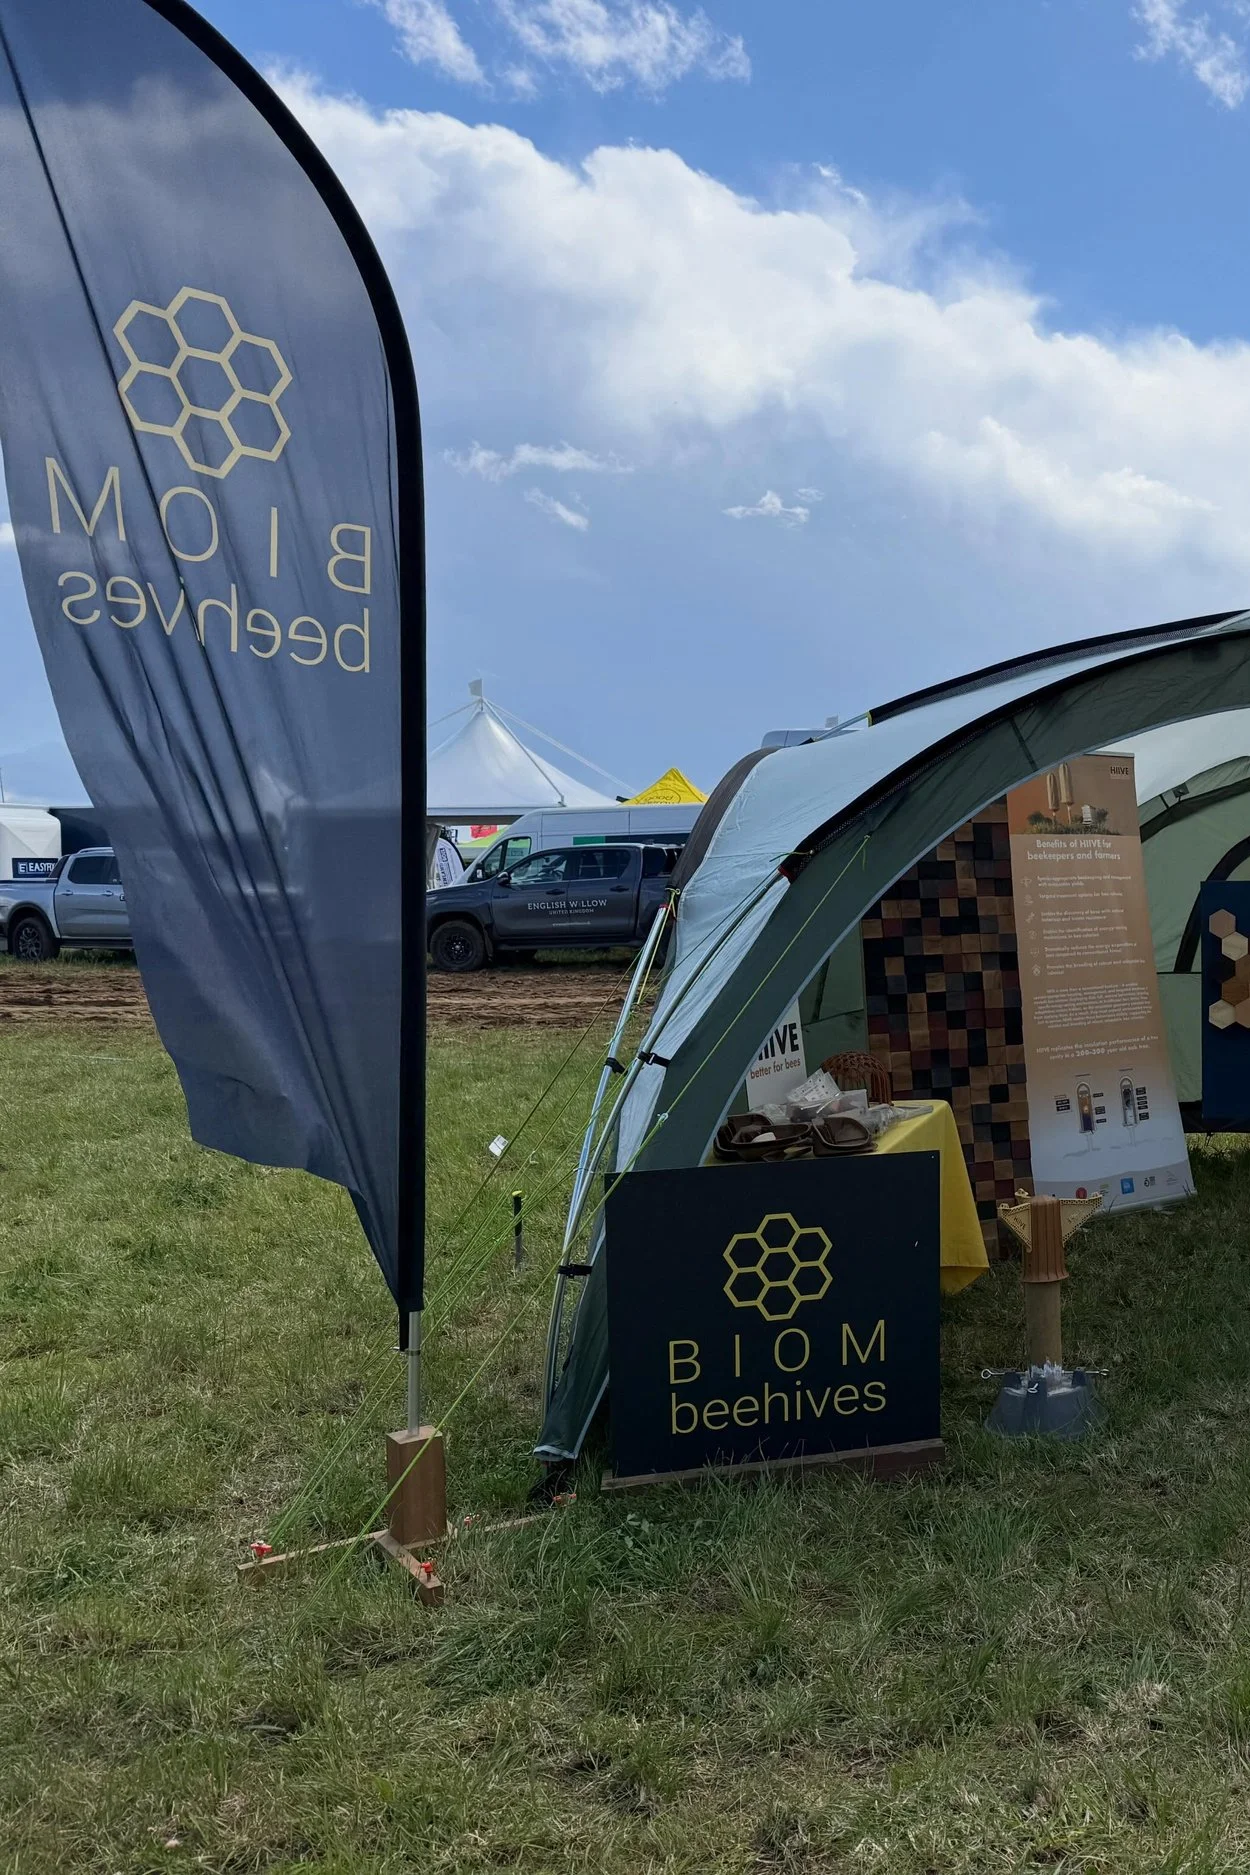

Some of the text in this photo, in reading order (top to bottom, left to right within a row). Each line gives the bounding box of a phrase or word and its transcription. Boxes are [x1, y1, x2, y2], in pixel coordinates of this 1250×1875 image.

[1110, 766, 1129, 776] HIIVE
[1036, 839, 1067, 849] Benefits
[1069, 839, 1078, 849] of
[1080, 839, 1101, 849] HIIVE
[1027, 850, 1121, 862] beekeepers and farmers
[528, 901, 566, 910] ENGLISH
[750, 1058, 801, 1079] better for bees
[669, 1319, 886, 1384] BIOM
[671, 1380, 887, 1434] beehives
